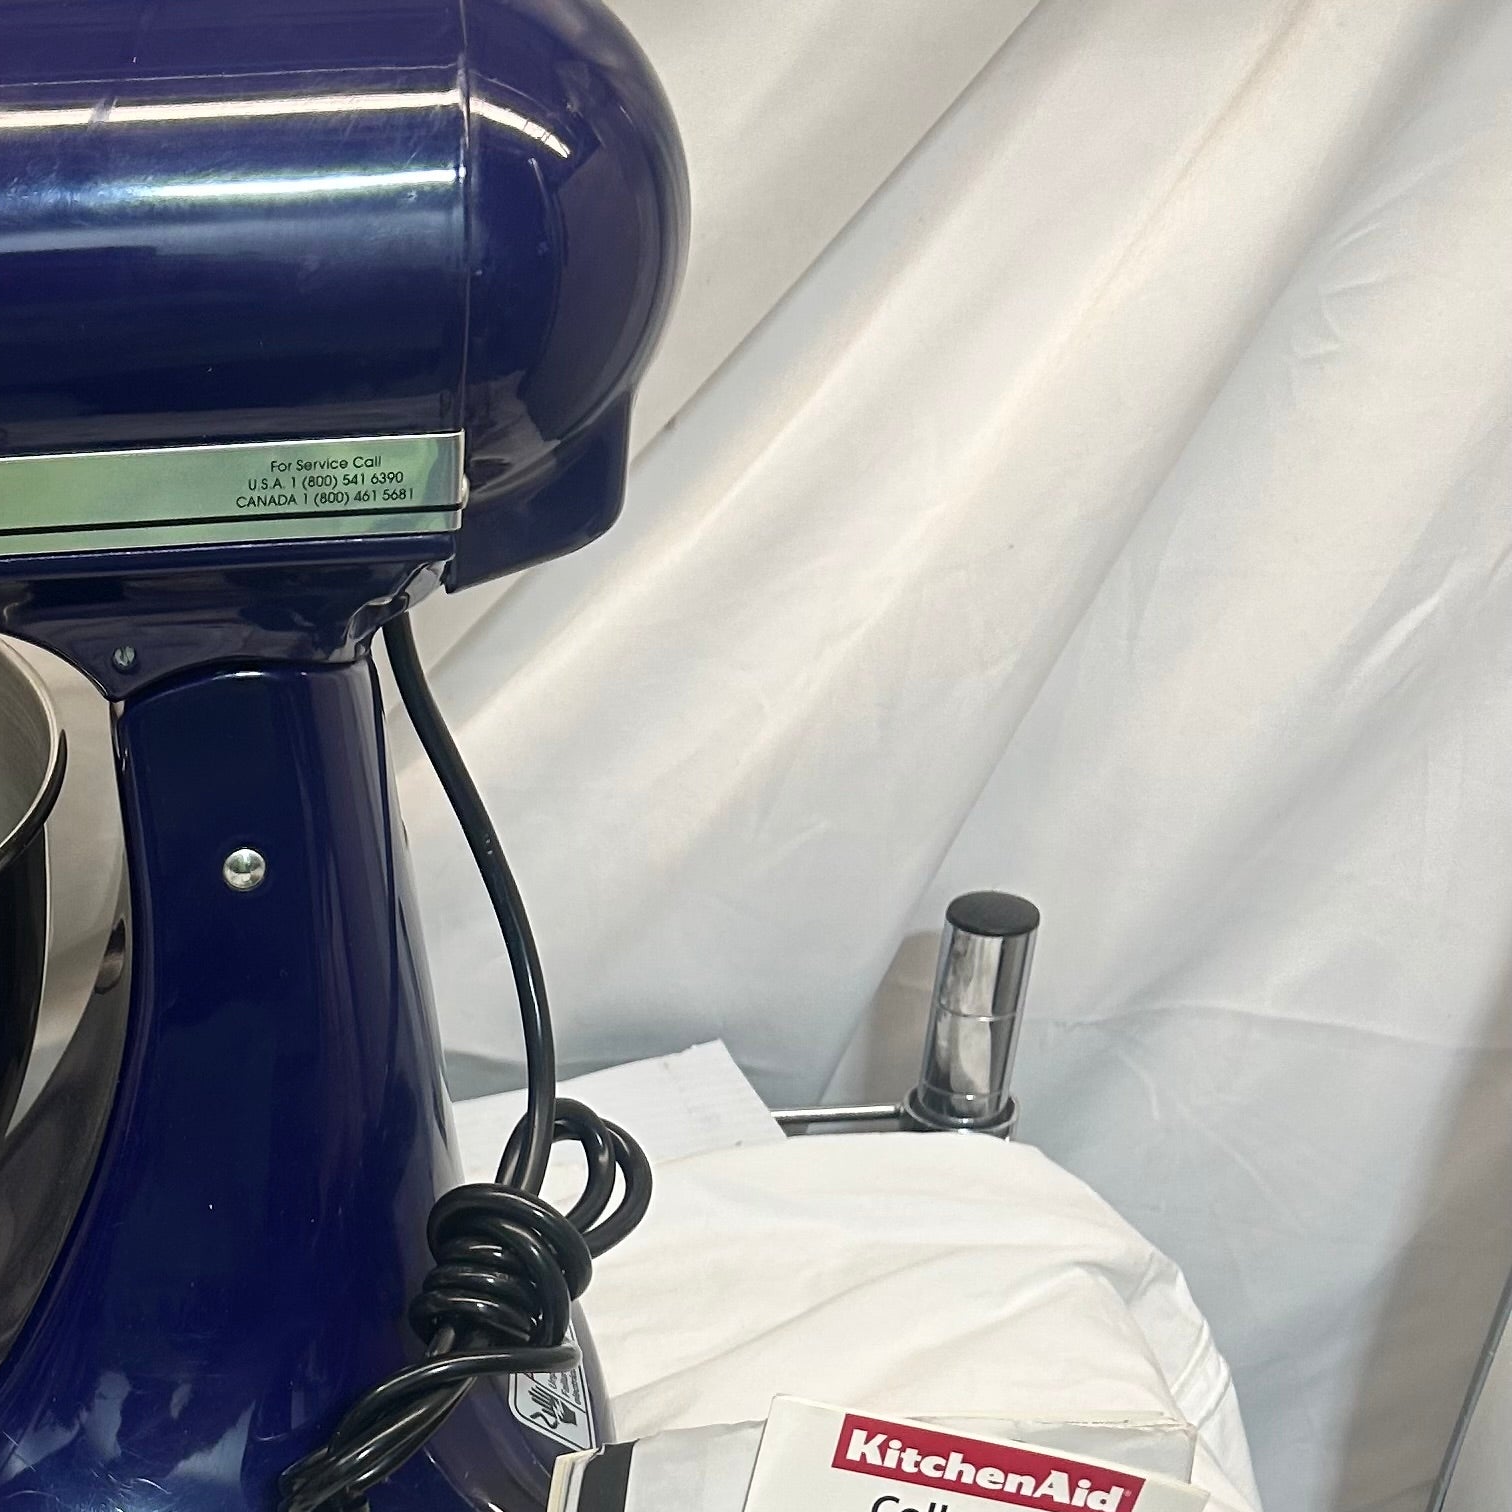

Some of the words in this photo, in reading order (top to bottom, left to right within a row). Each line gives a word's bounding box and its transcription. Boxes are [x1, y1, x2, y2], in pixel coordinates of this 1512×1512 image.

[271, 460, 292, 473] For
[296, 457, 348, 471] Service
[352, 455, 382, 469] Call
[291, 476, 296, 490] 1
[302, 475, 338, 490] (800)
[342, 473, 365, 487] 541
[371, 471, 404, 485] 6390
[236, 493, 298, 509] CANADA
[303, 492, 308, 506] 1
[313, 491, 350, 506] (800)
[353, 489, 377, 503] 461
[382, 487, 414, 502] 5681
